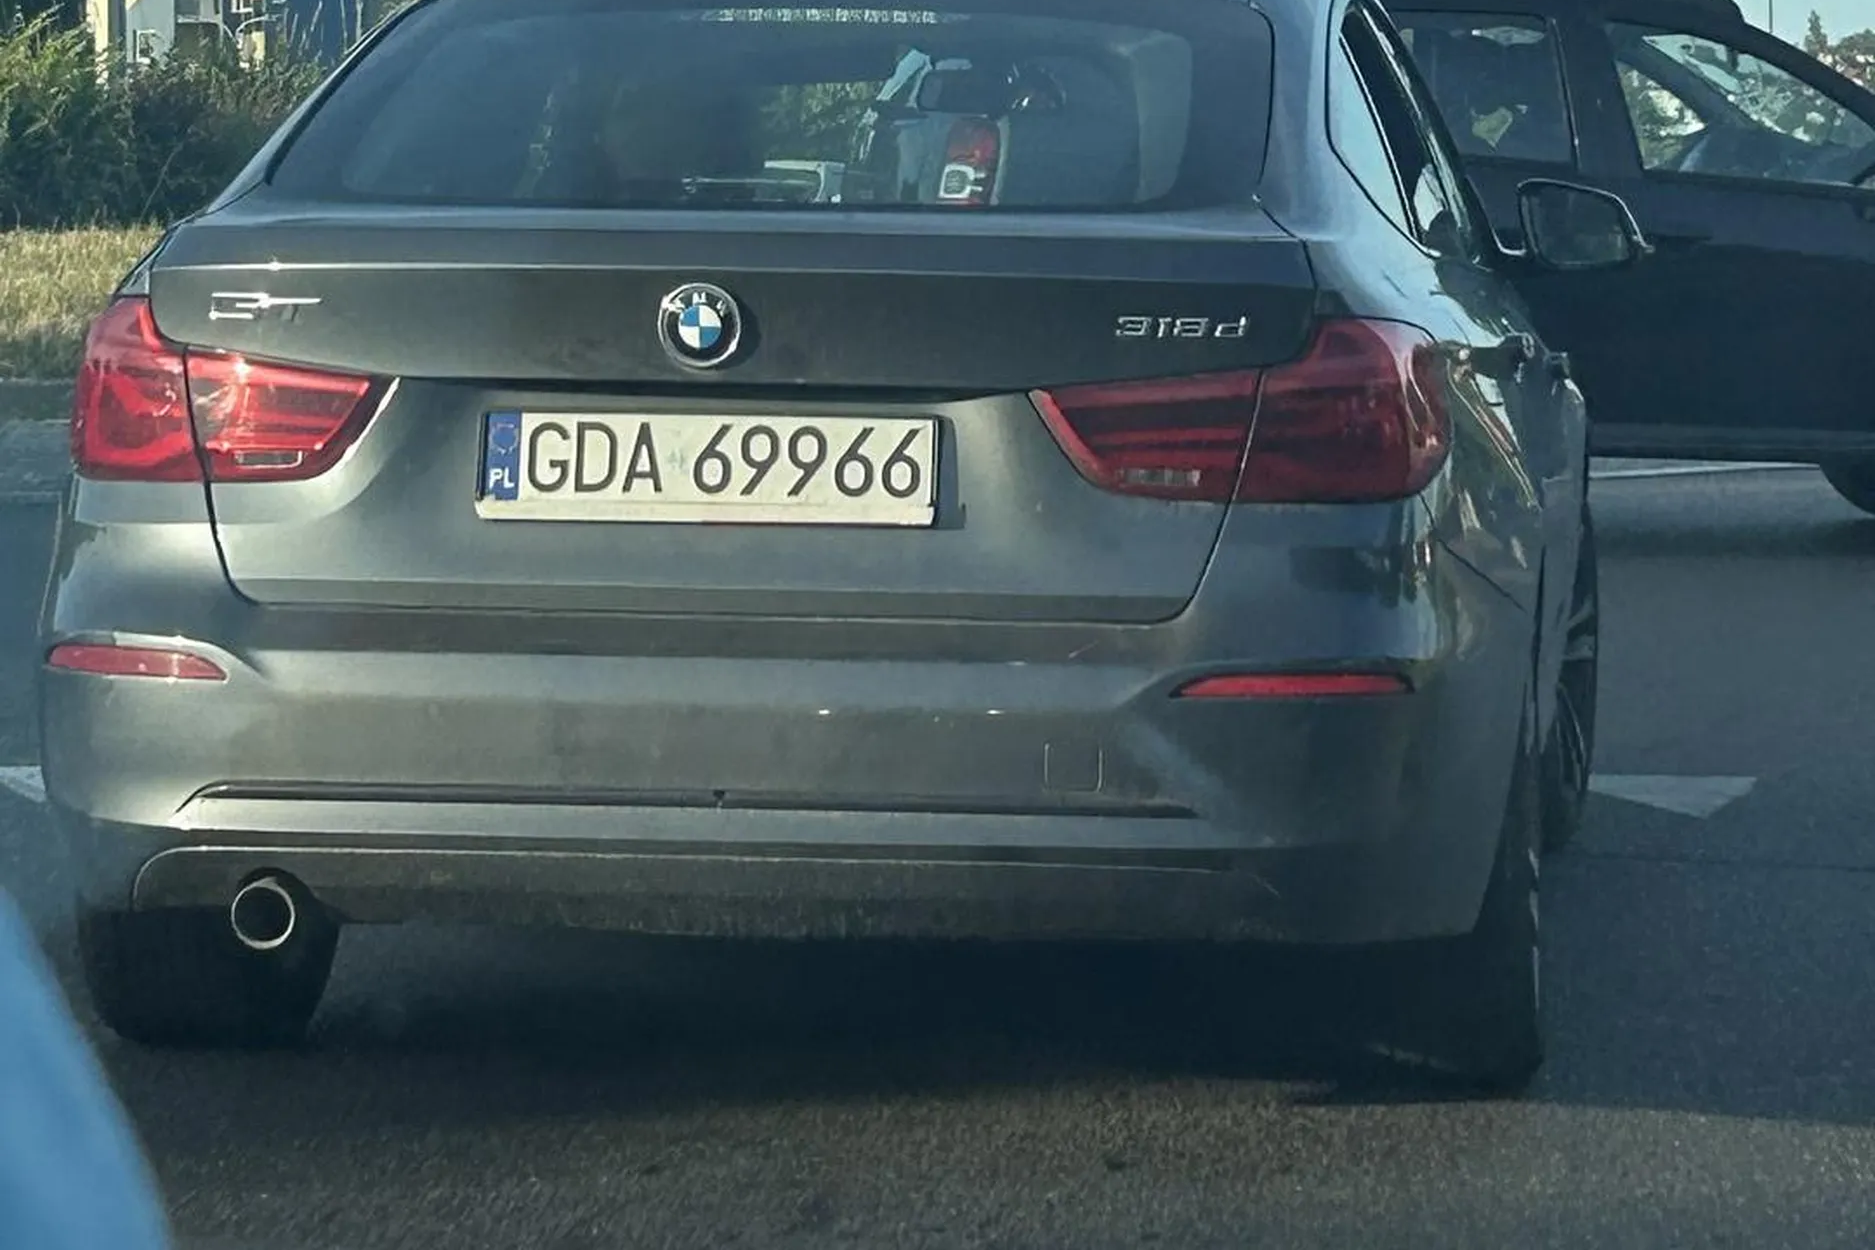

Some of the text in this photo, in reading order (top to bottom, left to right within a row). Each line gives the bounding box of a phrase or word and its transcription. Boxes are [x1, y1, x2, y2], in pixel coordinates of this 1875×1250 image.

[1115, 315, 1247, 339] 318d
[526, 421, 923, 499] GDA 69966
[489, 466, 516, 489] PL
